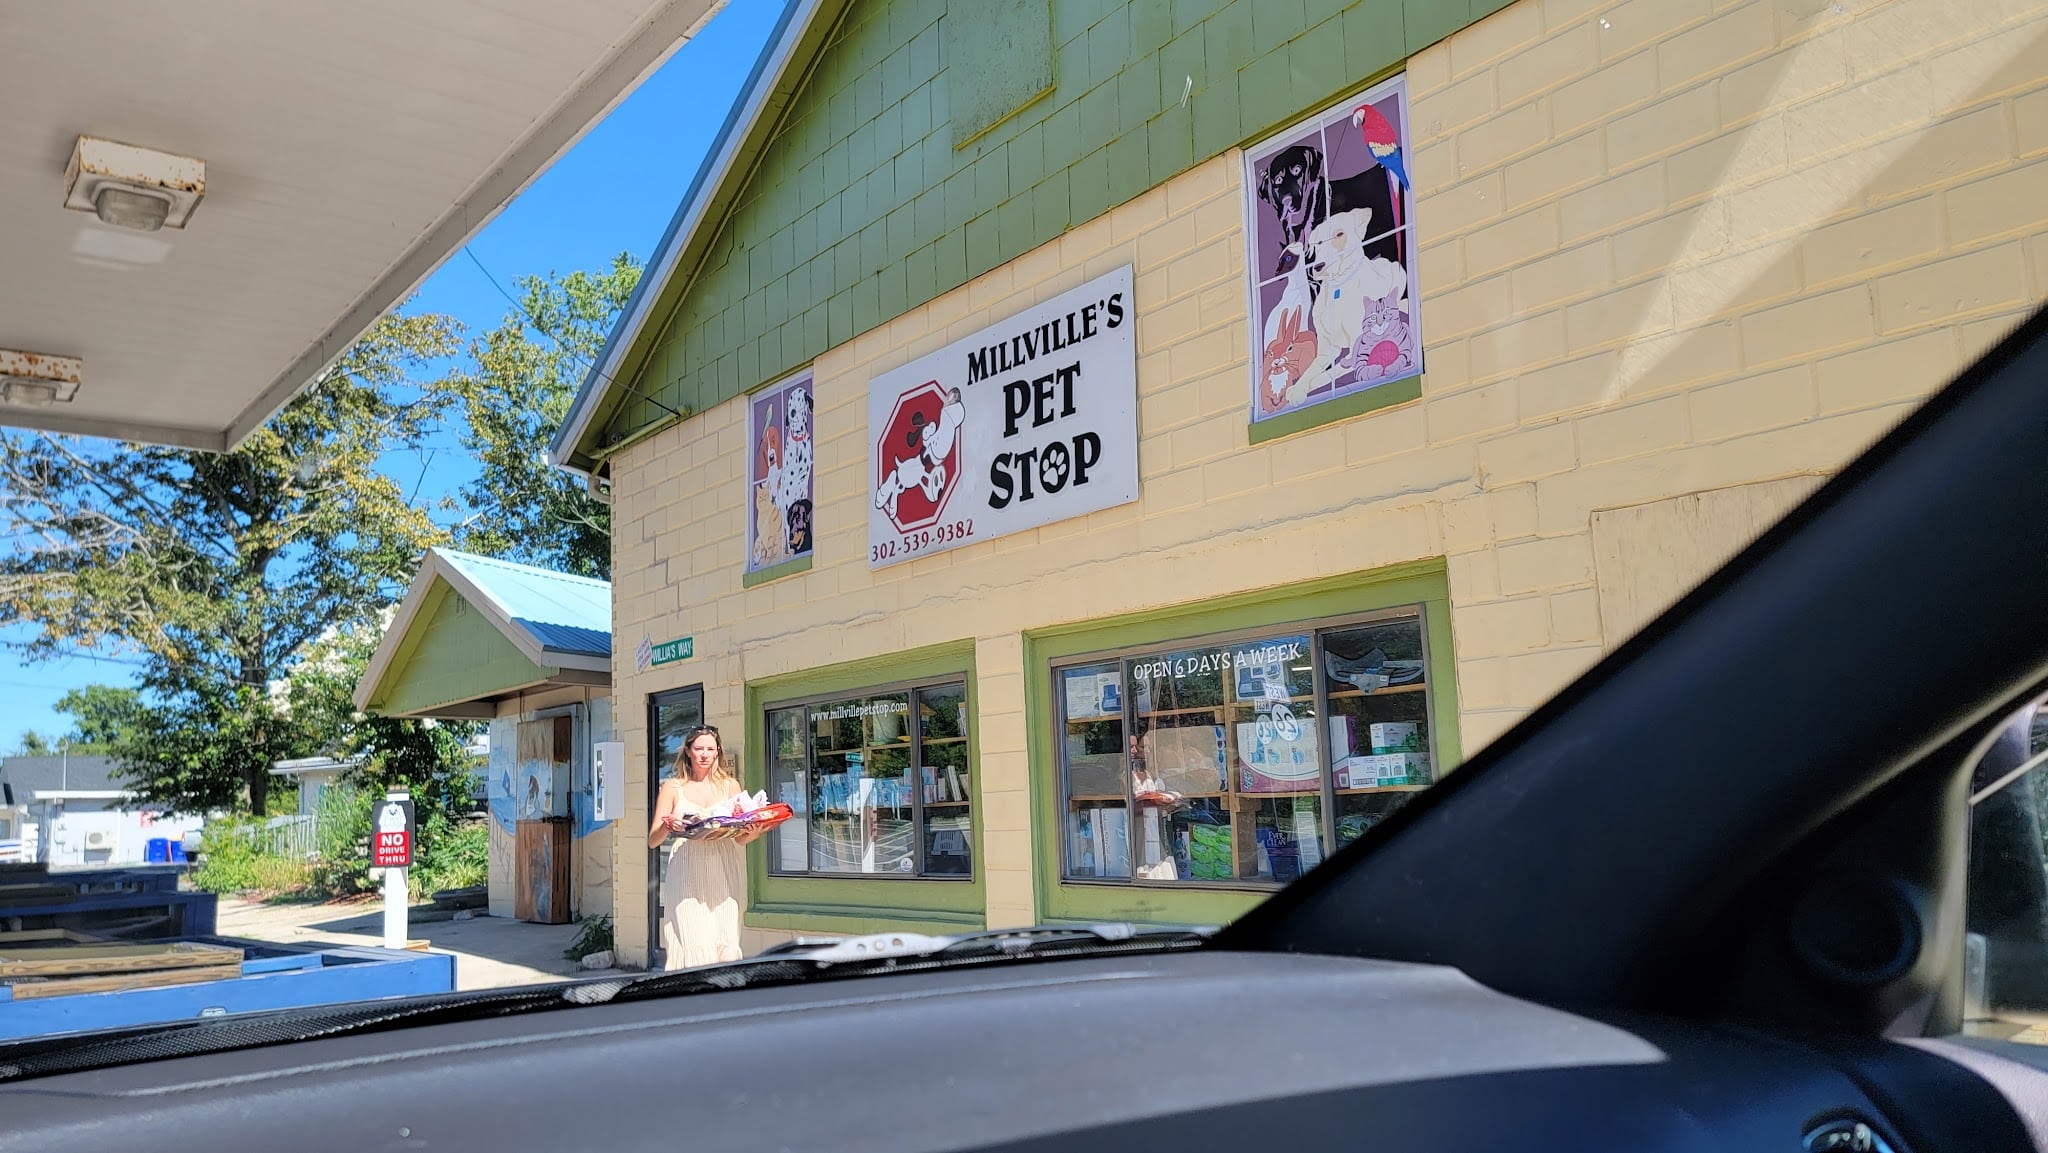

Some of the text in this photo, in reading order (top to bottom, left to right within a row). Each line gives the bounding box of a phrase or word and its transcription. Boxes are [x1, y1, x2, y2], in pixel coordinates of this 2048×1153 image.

[967, 292, 1124, 386] MILLVILLE'S
[1003, 361, 1081, 438] PET
[988, 431, 1101, 510] STOP
[872, 518, 974, 562] 302-539-9382
[678, 640, 692, 657] WAY
[1133, 643, 1302, 680] OPEN 6 DAYS A WEEK
[811, 702, 908, 722] www.millvillepetstop.com
[379, 846, 405, 855] DRIVE
[381, 834, 404, 846] NO
[379, 855, 406, 864] THRU
